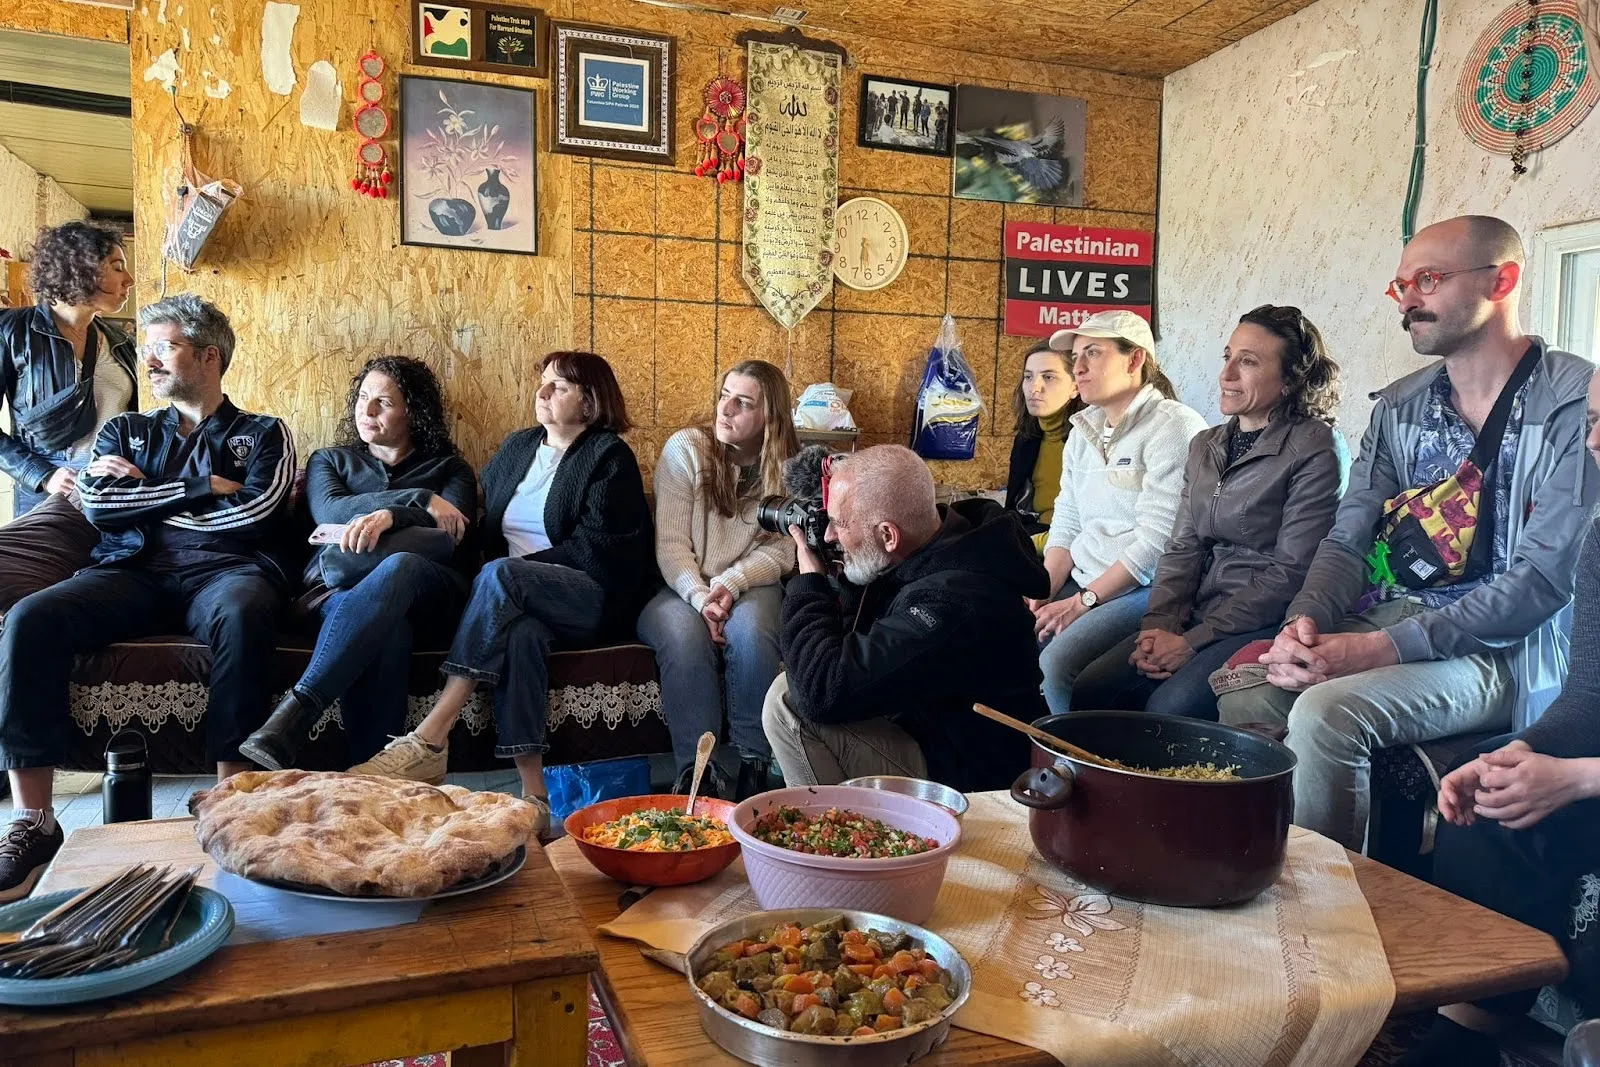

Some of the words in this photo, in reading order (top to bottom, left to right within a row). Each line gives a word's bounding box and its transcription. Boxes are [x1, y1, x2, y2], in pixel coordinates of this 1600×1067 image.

[491, 14, 510, 23] Palestine
[497, 25, 514, 33] Harvard
[612, 81, 640, 89] Palestine
[612, 87, 637, 96] Working
[612, 92, 630, 100] Group
[842, 214, 853, 226] 11
[856, 209, 868, 220] 12
[873, 211, 879, 222] 1
[835, 227, 847, 239] 10
[882, 222, 891, 233] 2
[888, 236, 897, 248] 3
[1016, 231, 1140, 258] Palestinian
[839, 256, 848, 269] 8
[885, 252, 893, 264] 4
[851, 266, 859, 279] 7
[863, 267, 872, 281] 6
[877, 264, 885, 276] 5
[1018, 267, 1130, 299] LIVES
[1039, 306, 1090, 326] Matt
[229, 436, 254, 447] NETS
